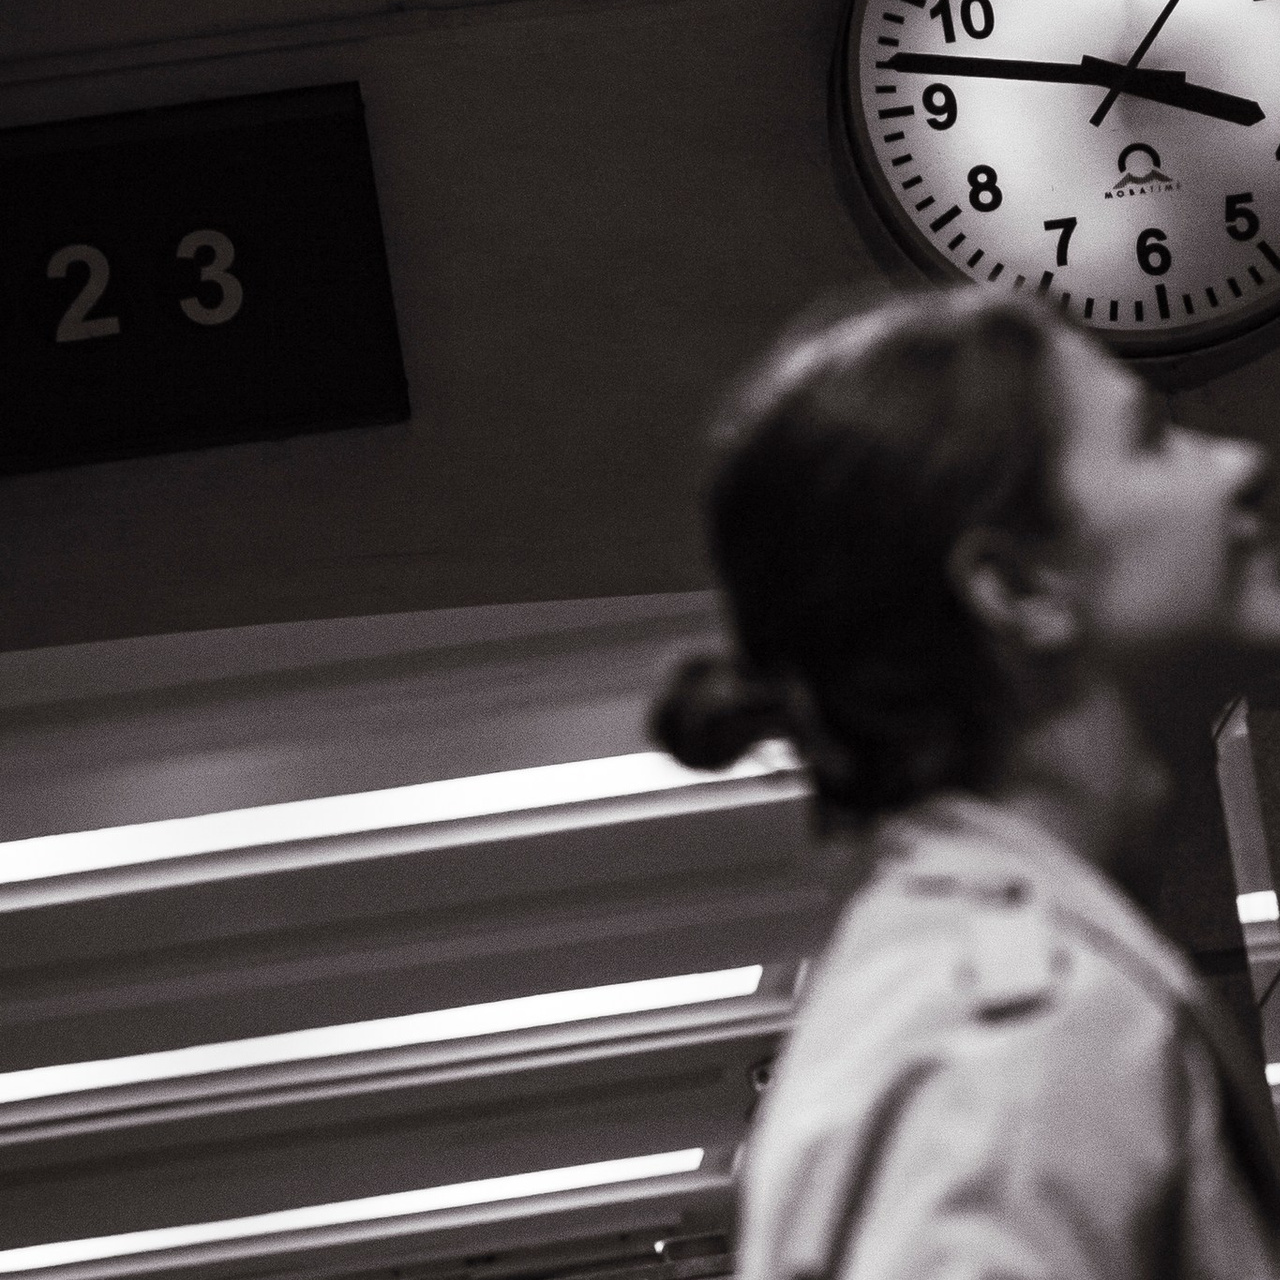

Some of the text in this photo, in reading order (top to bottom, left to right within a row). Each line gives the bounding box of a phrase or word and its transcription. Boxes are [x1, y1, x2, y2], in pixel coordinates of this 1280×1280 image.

[922, 83, 958, 131] 9
[966, 164, 1003, 213] 8
[1044, 216, 1077, 267] 7
[1225, 192, 1261, 242] 5
[1136, 227, 1173, 277] 6
[46, 229, 244, 343] 2 3
